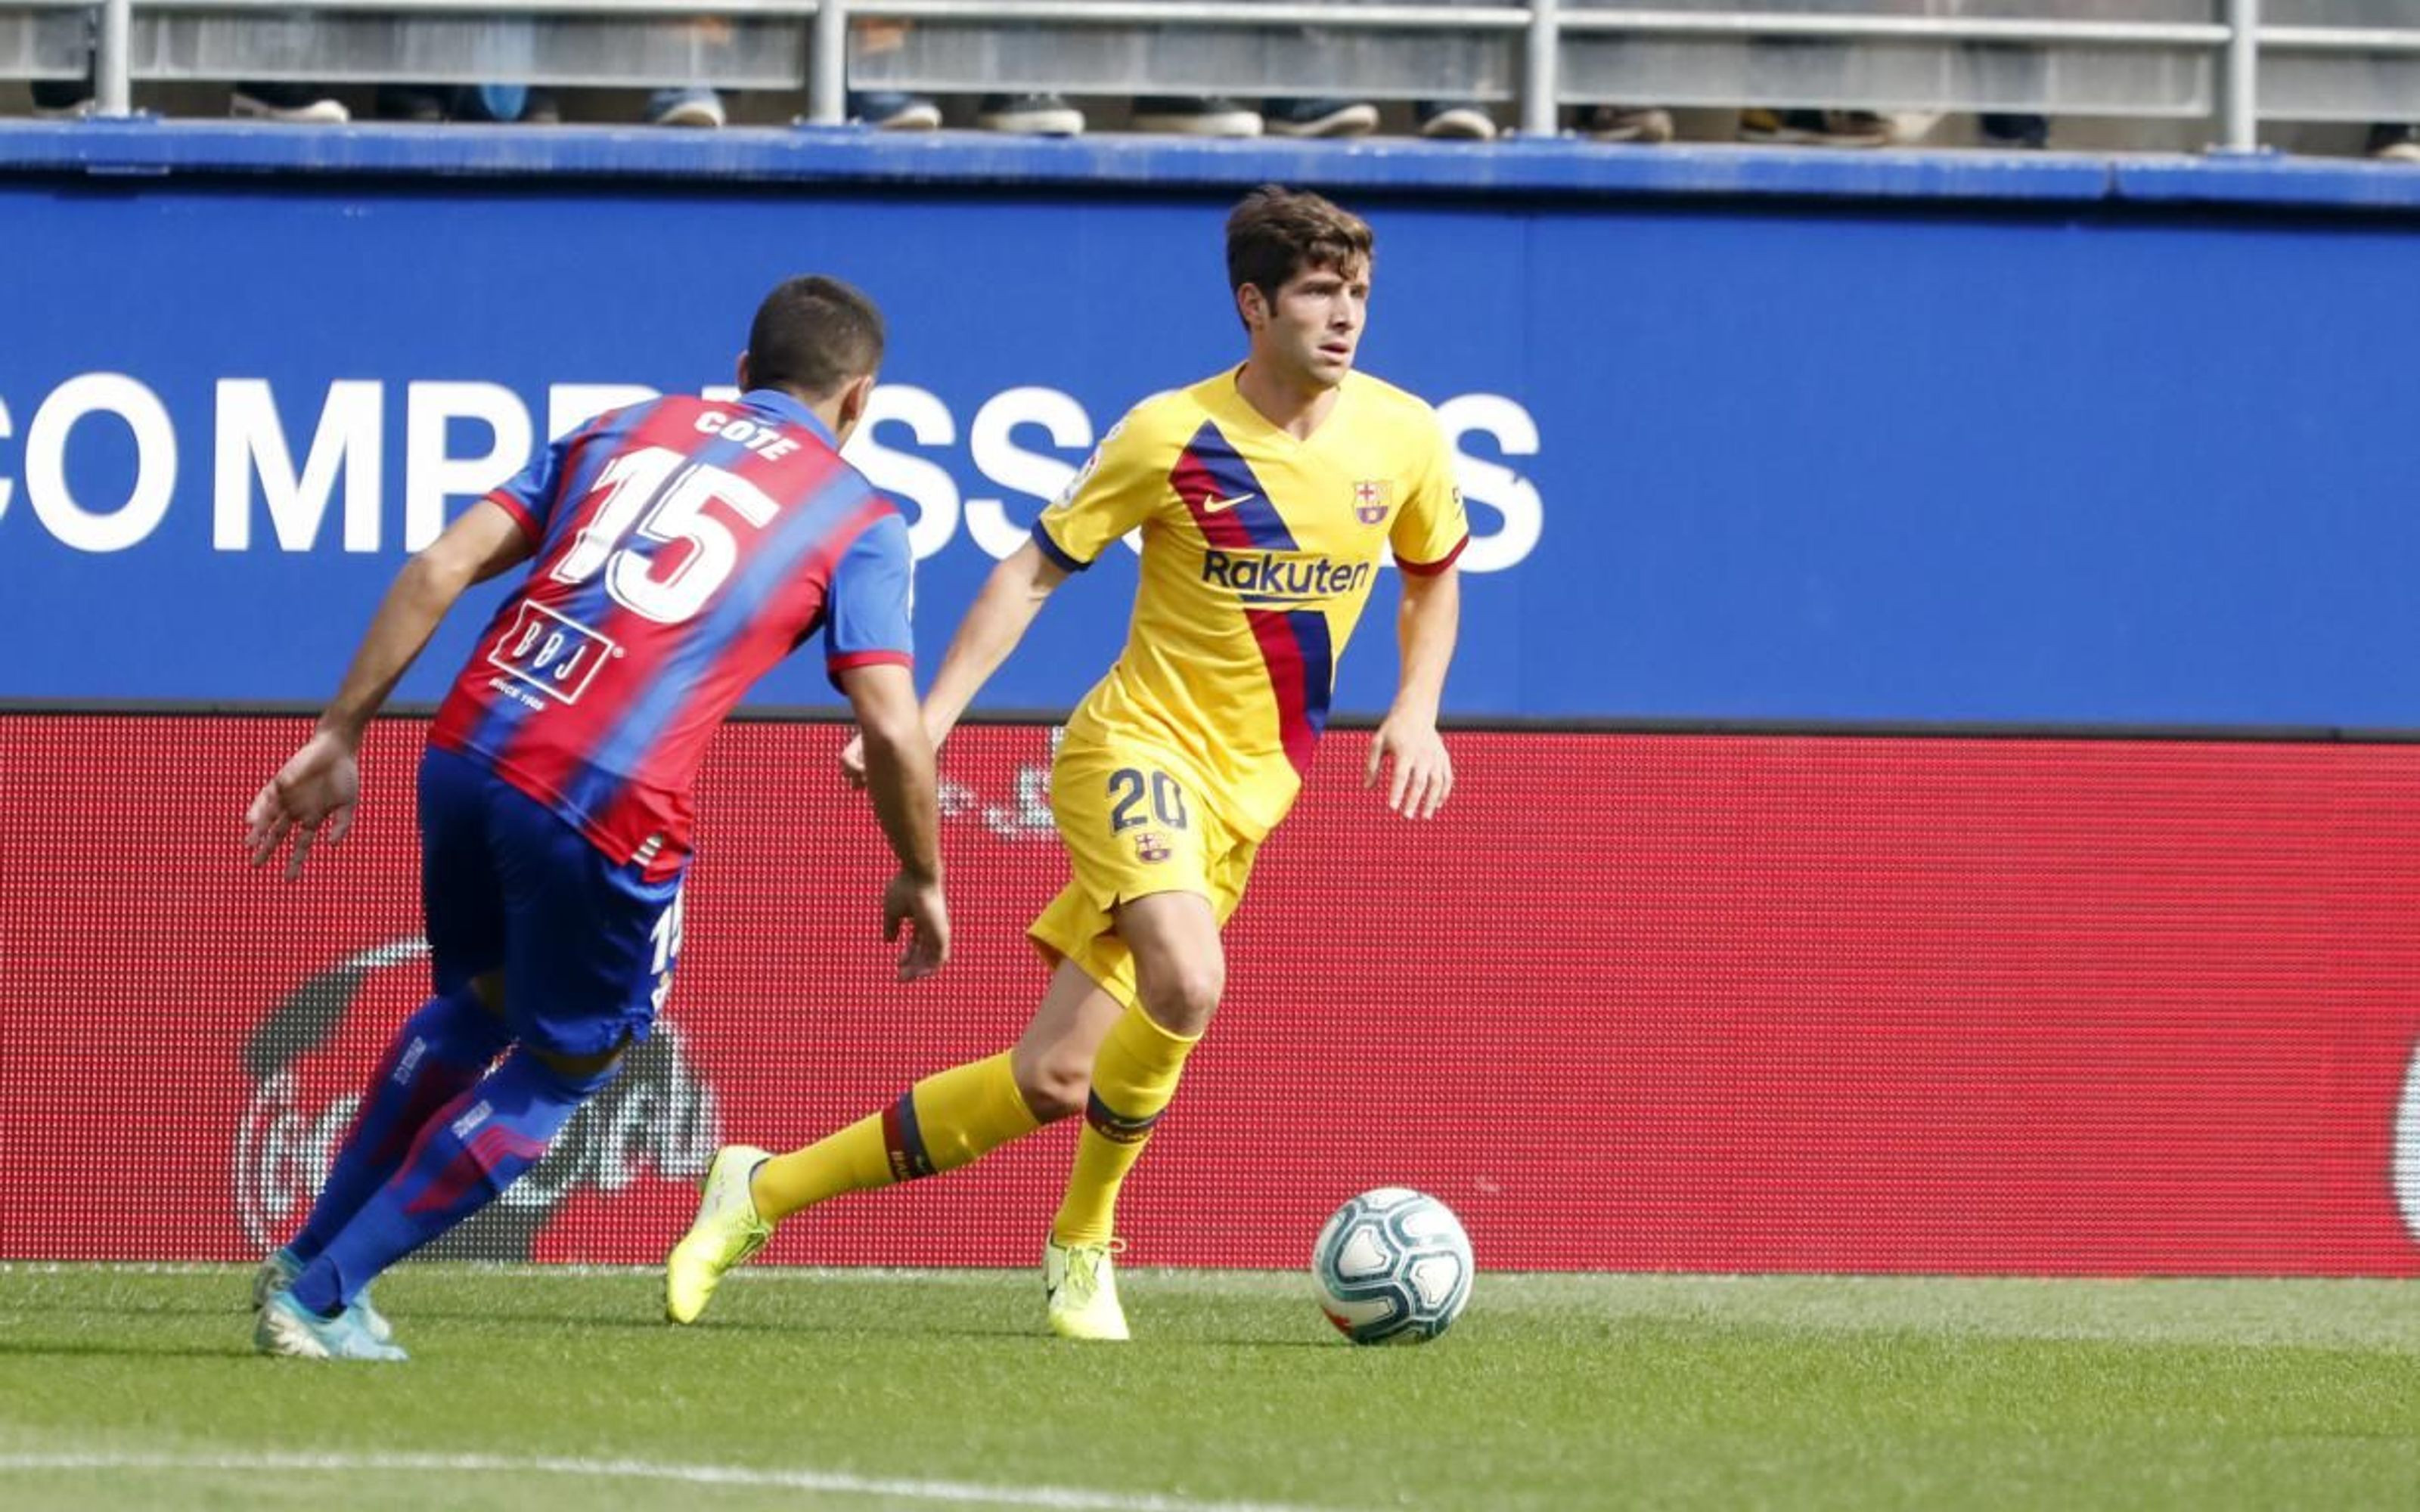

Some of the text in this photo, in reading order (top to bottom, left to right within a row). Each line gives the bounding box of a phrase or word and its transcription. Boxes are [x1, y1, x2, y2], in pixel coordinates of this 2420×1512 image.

[693, 411, 802, 462] COTE
[548, 446, 781, 624] 15
[1202, 550, 1370, 593] Rakuten
[1109, 767, 1187, 835] 20
